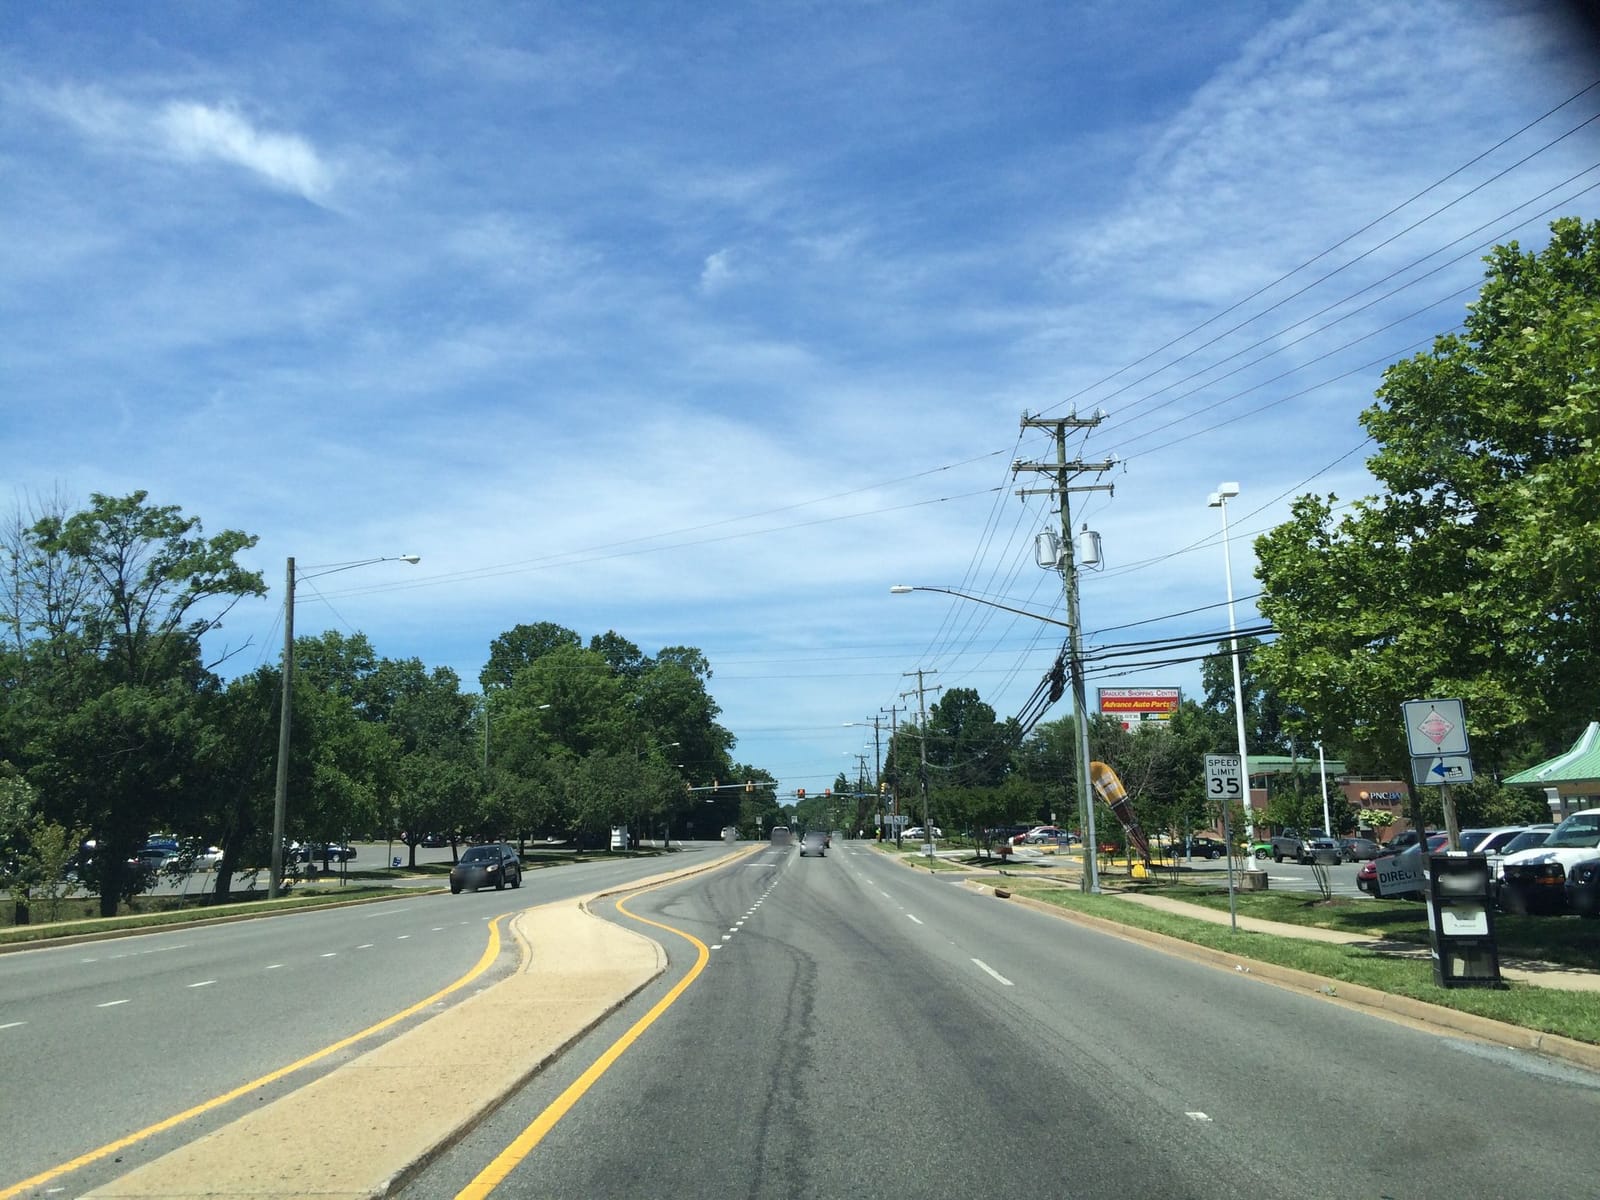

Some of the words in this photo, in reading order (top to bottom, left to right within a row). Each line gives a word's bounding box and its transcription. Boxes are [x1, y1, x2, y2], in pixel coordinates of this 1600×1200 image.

[1208, 759, 1239, 767] SPEED
[1211, 768, 1236, 776] LIMIT
[1211, 778, 1240, 794] 35
[1370, 791, 1389, 800] PNC
